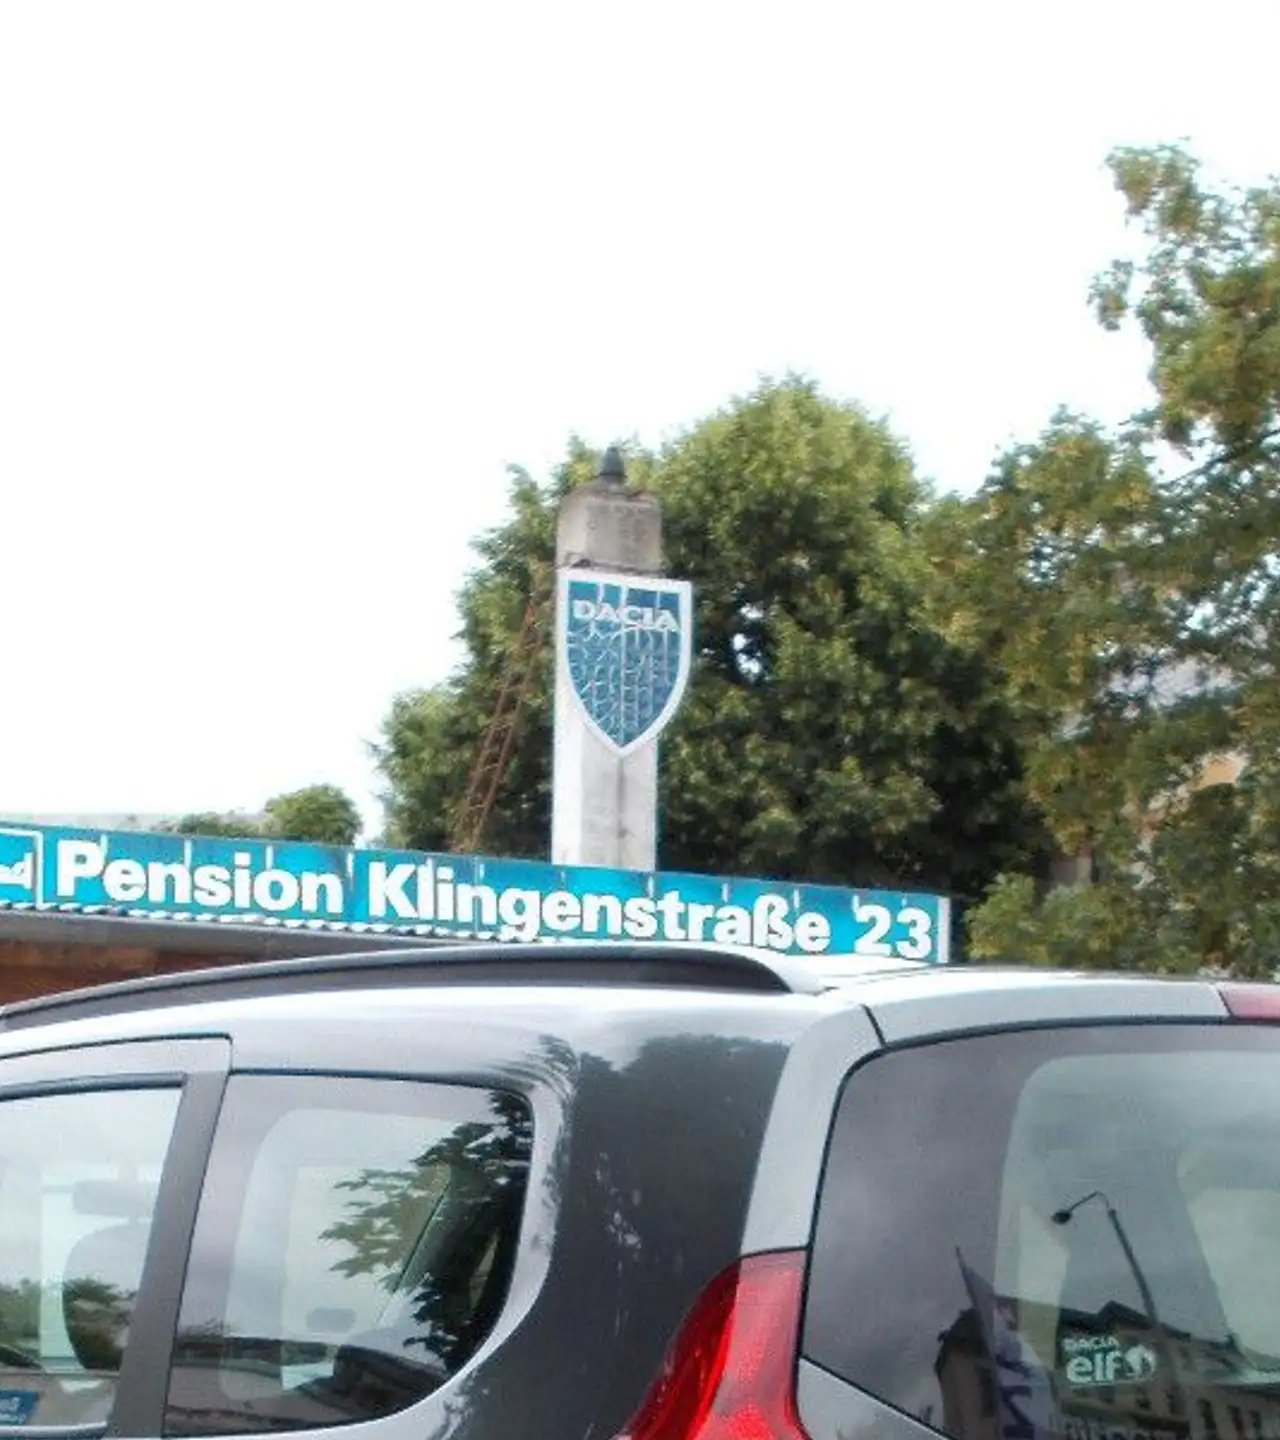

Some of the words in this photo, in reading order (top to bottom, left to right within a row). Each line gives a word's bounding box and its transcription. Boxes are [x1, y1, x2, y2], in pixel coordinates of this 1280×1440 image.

[572, 599, 681, 631] DACIA
[56, 838, 344, 915] Pension
[367, 859, 831, 954] Klingenstraße
[854, 902, 932, 960] 23
[1065, 1350, 1124, 1384] elf
